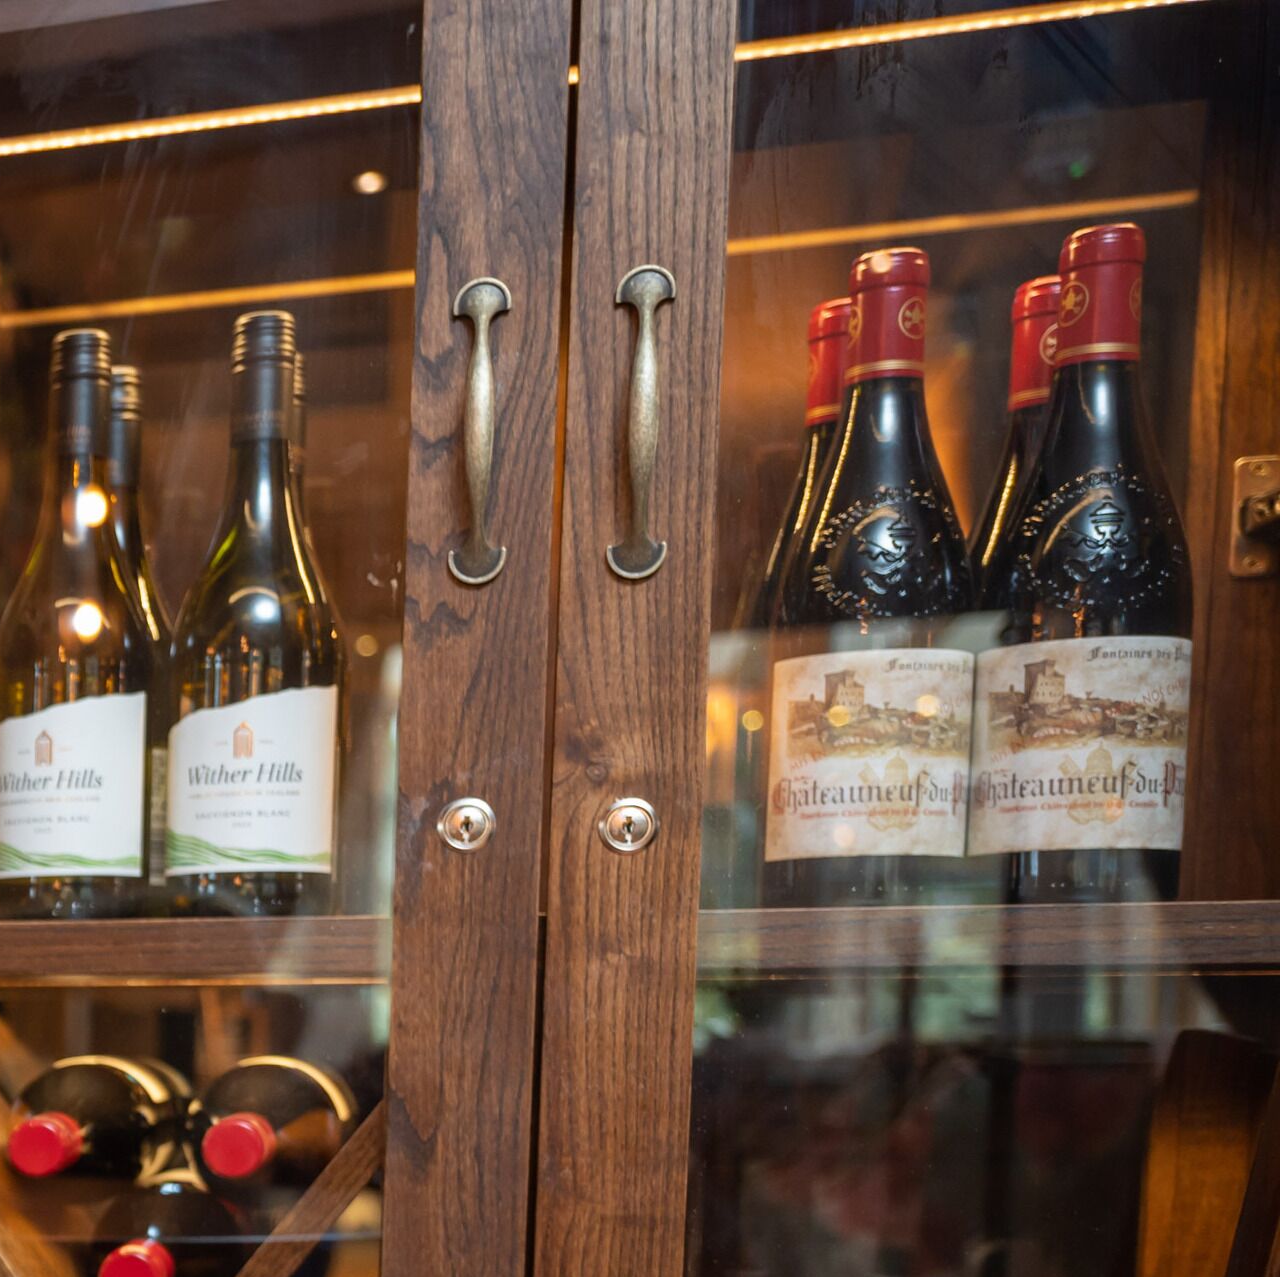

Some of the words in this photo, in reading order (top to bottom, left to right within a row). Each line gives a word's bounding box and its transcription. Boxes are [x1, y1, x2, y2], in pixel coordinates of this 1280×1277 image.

[56, 769, 104, 789] Hills
[188, 763, 254, 786] Wither
[256, 762, 304, 783] Hills
